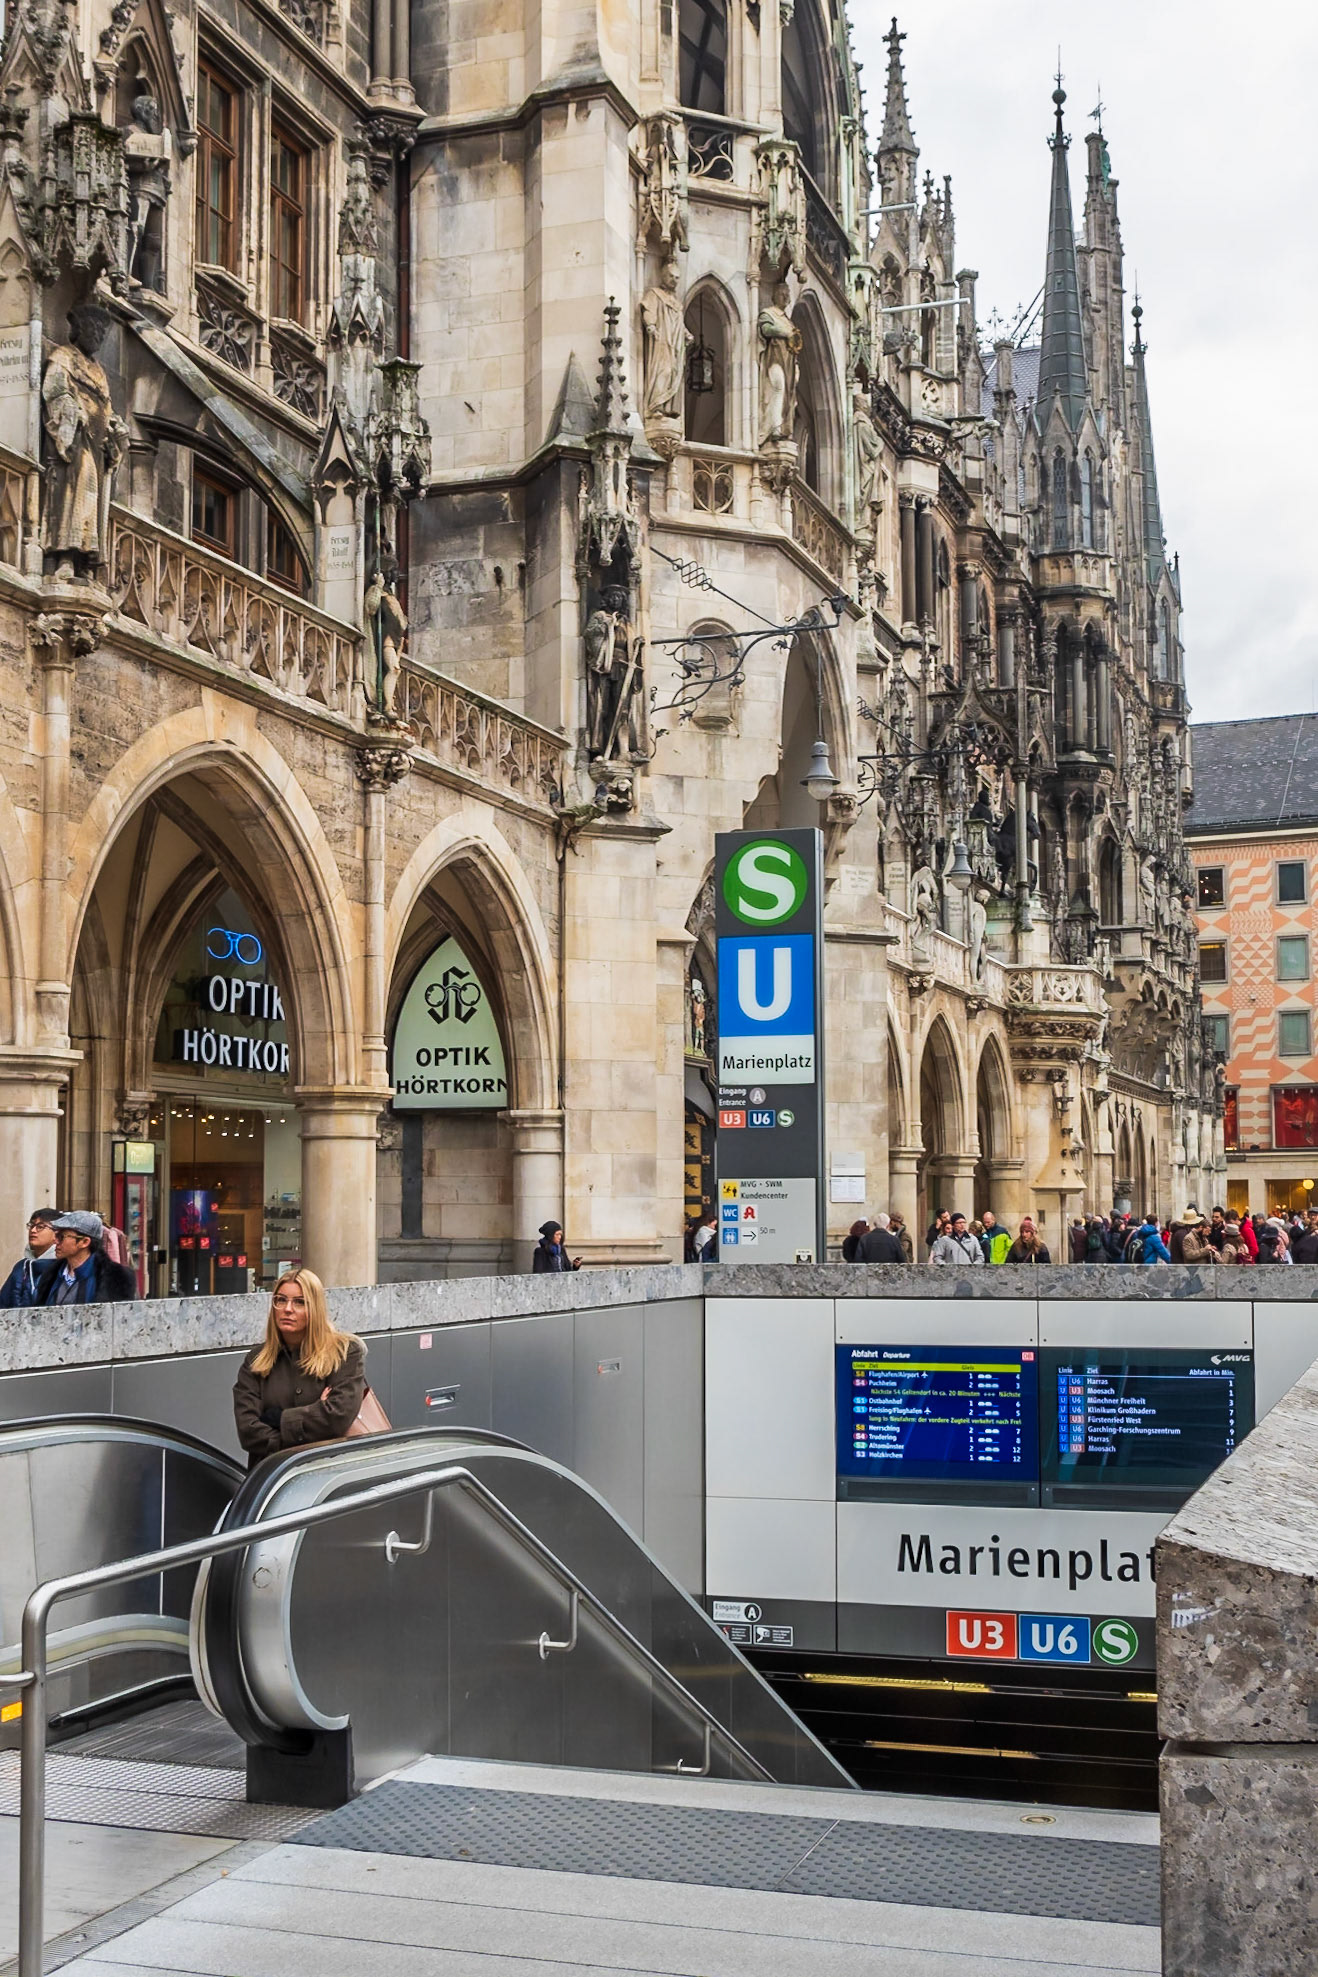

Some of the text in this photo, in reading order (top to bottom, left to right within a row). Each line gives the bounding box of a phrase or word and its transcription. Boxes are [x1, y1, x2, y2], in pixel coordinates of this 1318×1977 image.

[738, 846, 796, 920] S
[738, 948, 792, 1022] U
[209, 975, 286, 1020] OPTIK
[416, 1047, 492, 1067] OPTIK
[722, 1054, 812, 1072] Marienplatz
[396, 1074, 508, 1094] HÖRTKORN
[718, 1088, 746, 1096] Eingang
[718, 1098, 746, 1106] Entrance
[724, 1110, 792, 1126] U3 U6 S
[740, 1192, 788, 1200] Kundencenter
[724, 1208, 738, 1218] WC
[851, 1350, 878, 1358] Abfahrt
[869, 1371, 920, 1379] Flughafen/Airport
[869, 1407, 923, 1415] Freising/Flughafen
[1088, 1426, 1181, 1435] Garching-Forschungszentrum
[715, 1603, 740, 1612] Eingang
[959, 1619, 1130, 1659] U3 U6 S
